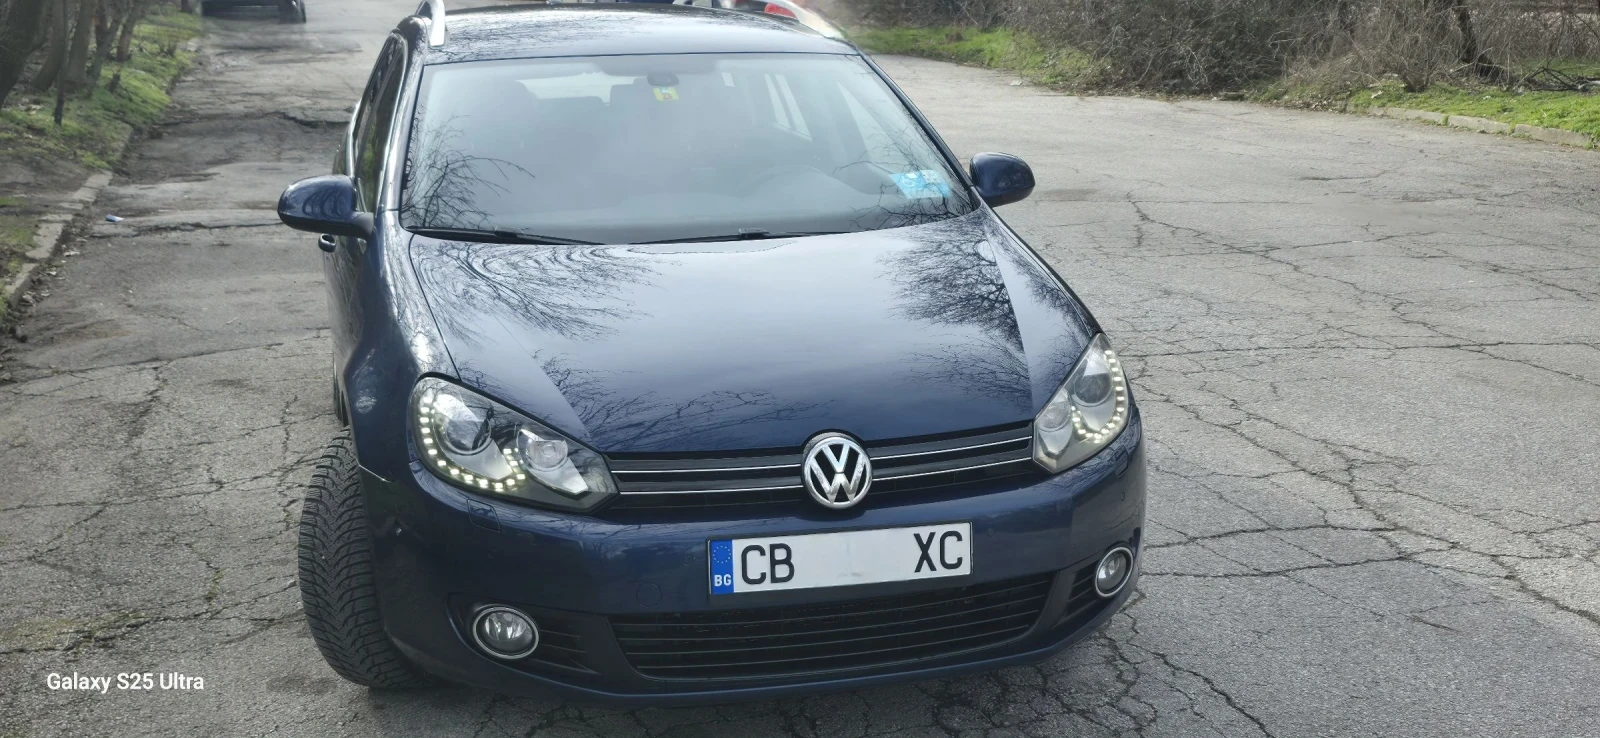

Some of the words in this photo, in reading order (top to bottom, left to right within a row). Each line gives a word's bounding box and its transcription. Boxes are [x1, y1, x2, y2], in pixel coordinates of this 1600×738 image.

[741, 543, 795, 585] CB
[913, 530, 963, 573] XC
[714, 574, 732, 587] BG
